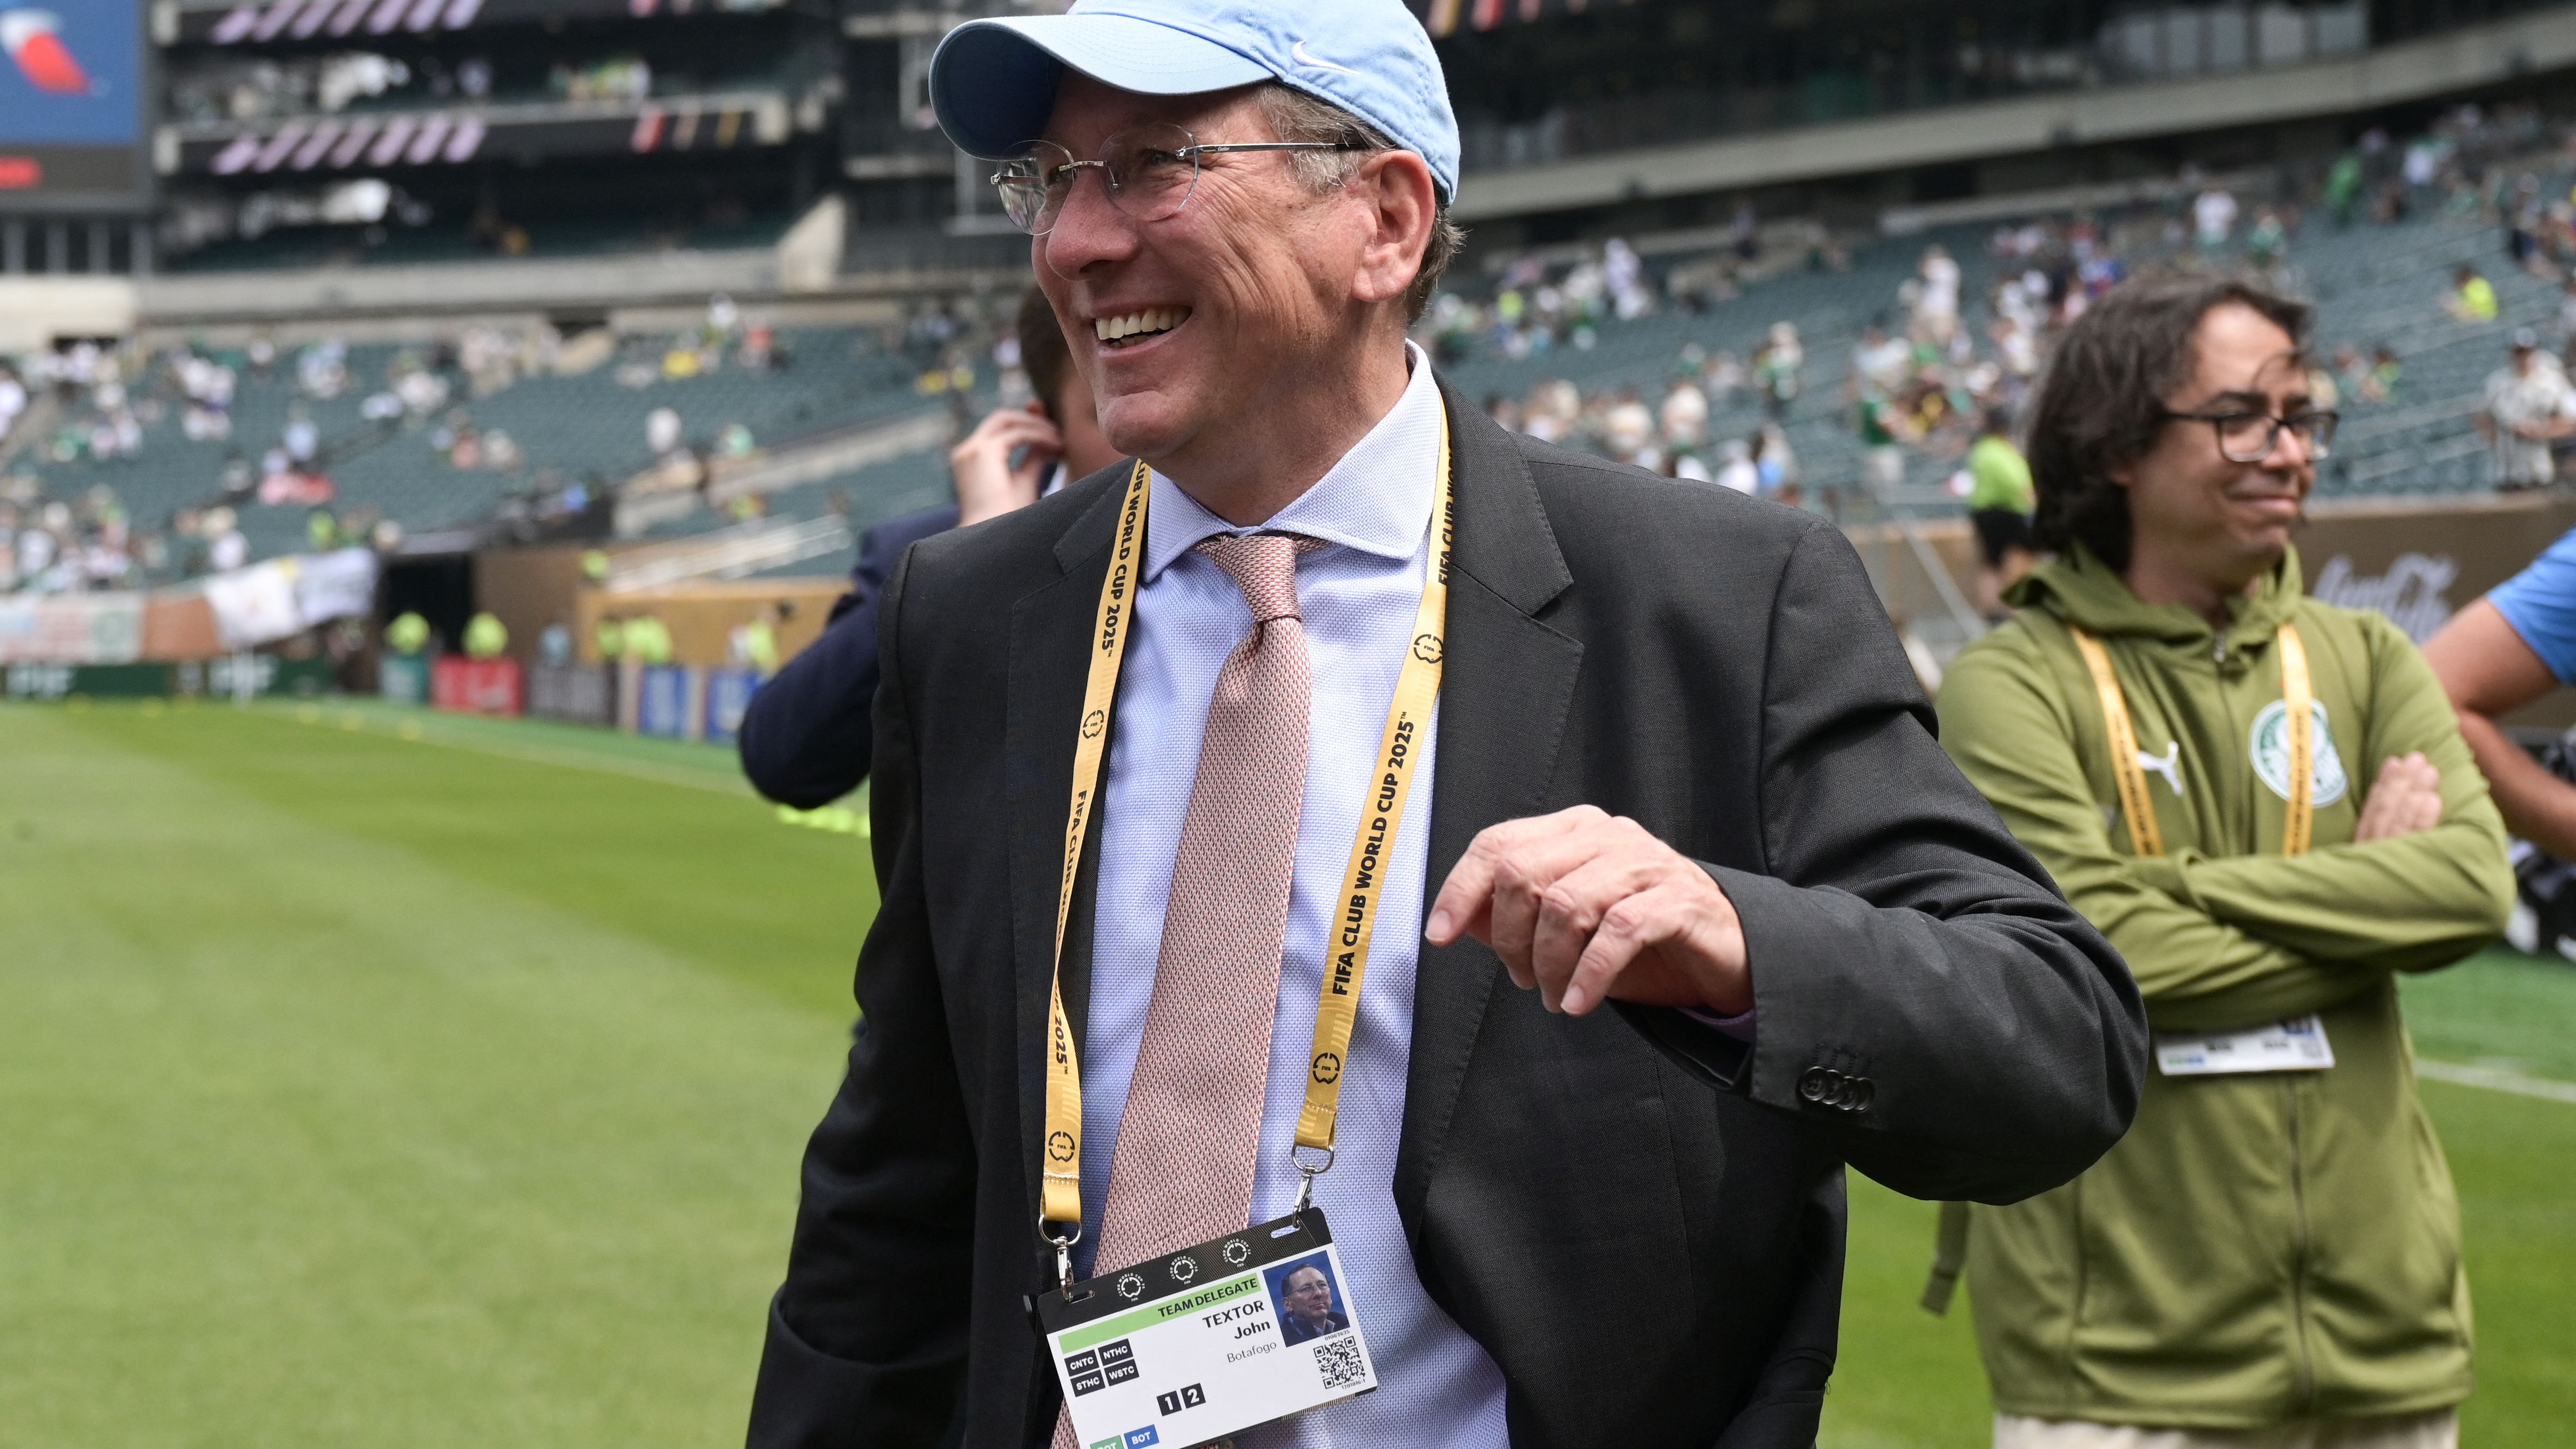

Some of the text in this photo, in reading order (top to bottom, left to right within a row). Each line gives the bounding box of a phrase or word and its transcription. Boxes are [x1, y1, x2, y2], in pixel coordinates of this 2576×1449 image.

[1119, 494, 1141, 560] WORLD
[1110, 564, 1127, 600] CUP
[1071, 790, 1087, 832] FIFA
[1377, 773, 1398, 813] CUP
[1065, 835, 1077, 885] CLUB
[1354, 817, 1387, 889] WORLD
[1342, 894, 1366, 947] CLUB
[1332, 952, 1355, 996] FIFA
[1158, 1278, 1258, 1317] TEAM DELEGATE
[1202, 1300, 1265, 1328] TEXTOR
[1234, 1321, 1271, 1339] John
[1070, 1345, 1128, 1370] CNTC NTHC
[1226, 1342, 1277, 1363] Botafogo
[1076, 1365, 1135, 1391] STHC WSTC
[1164, 1388, 1200, 1411] 1 2
[1131, 1431, 1151, 1445] BOT
